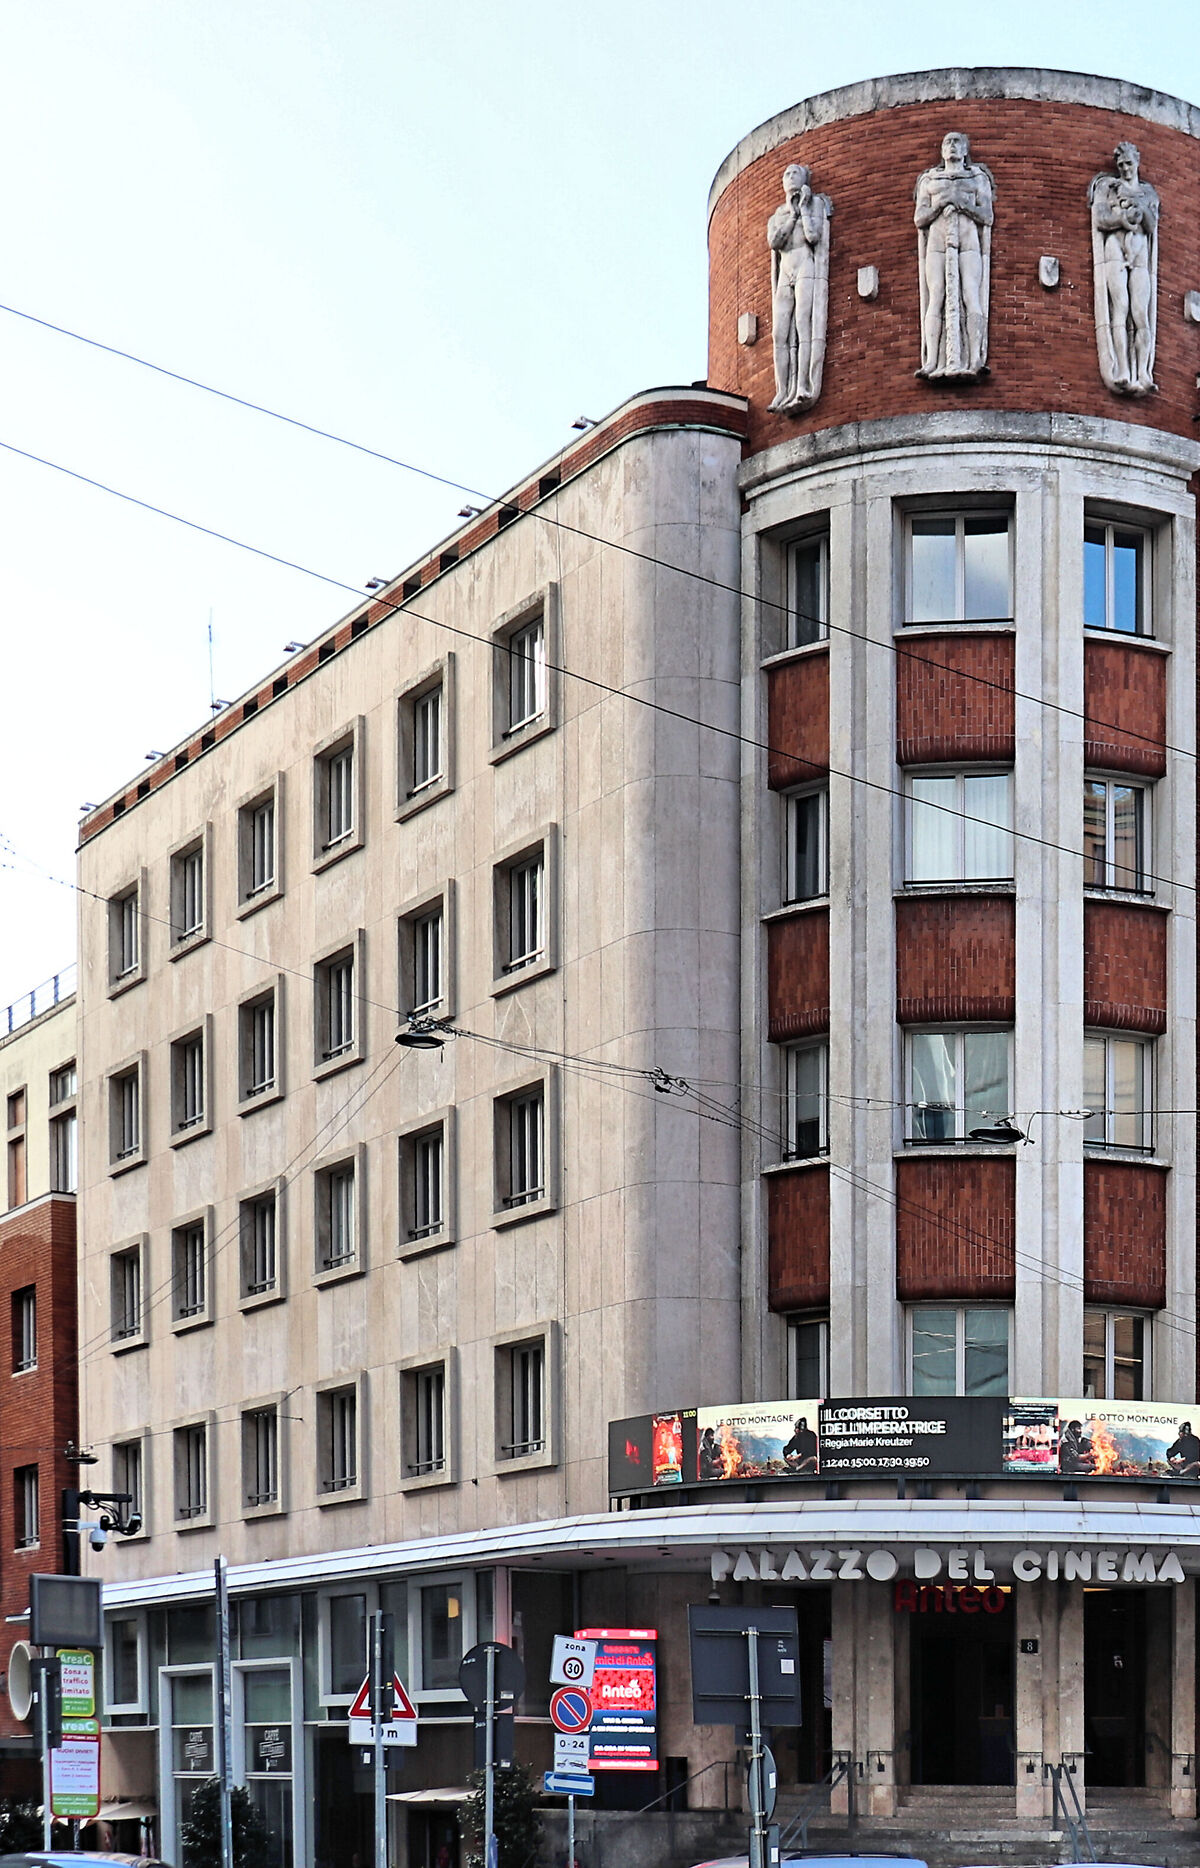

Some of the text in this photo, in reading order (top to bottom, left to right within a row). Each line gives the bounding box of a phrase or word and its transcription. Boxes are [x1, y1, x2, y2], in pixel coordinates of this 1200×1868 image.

[838, 1407, 909, 1421] CORSETTO
[1085, 1413, 1179, 1425] LE OTTO MONTAGNE
[716, 1414, 794, 1427] LE OTTO MONTAGNE
[822, 1438, 849, 1450] Regia
[710, 1549, 1186, 1583] PALAZZO DEL CINEMA
[894, 1578, 1006, 1614] Anteo
[565, 1643, 586, 1652] zona
[1026, 1641, 1034, 1652] 8
[595, 1656, 615, 1665] mici
[567, 1663, 580, 1675] 30
[62, 1677, 89, 1685] traffico
[602, 1685, 642, 1698] Anteo
[387, 1730, 398, 1738] m
